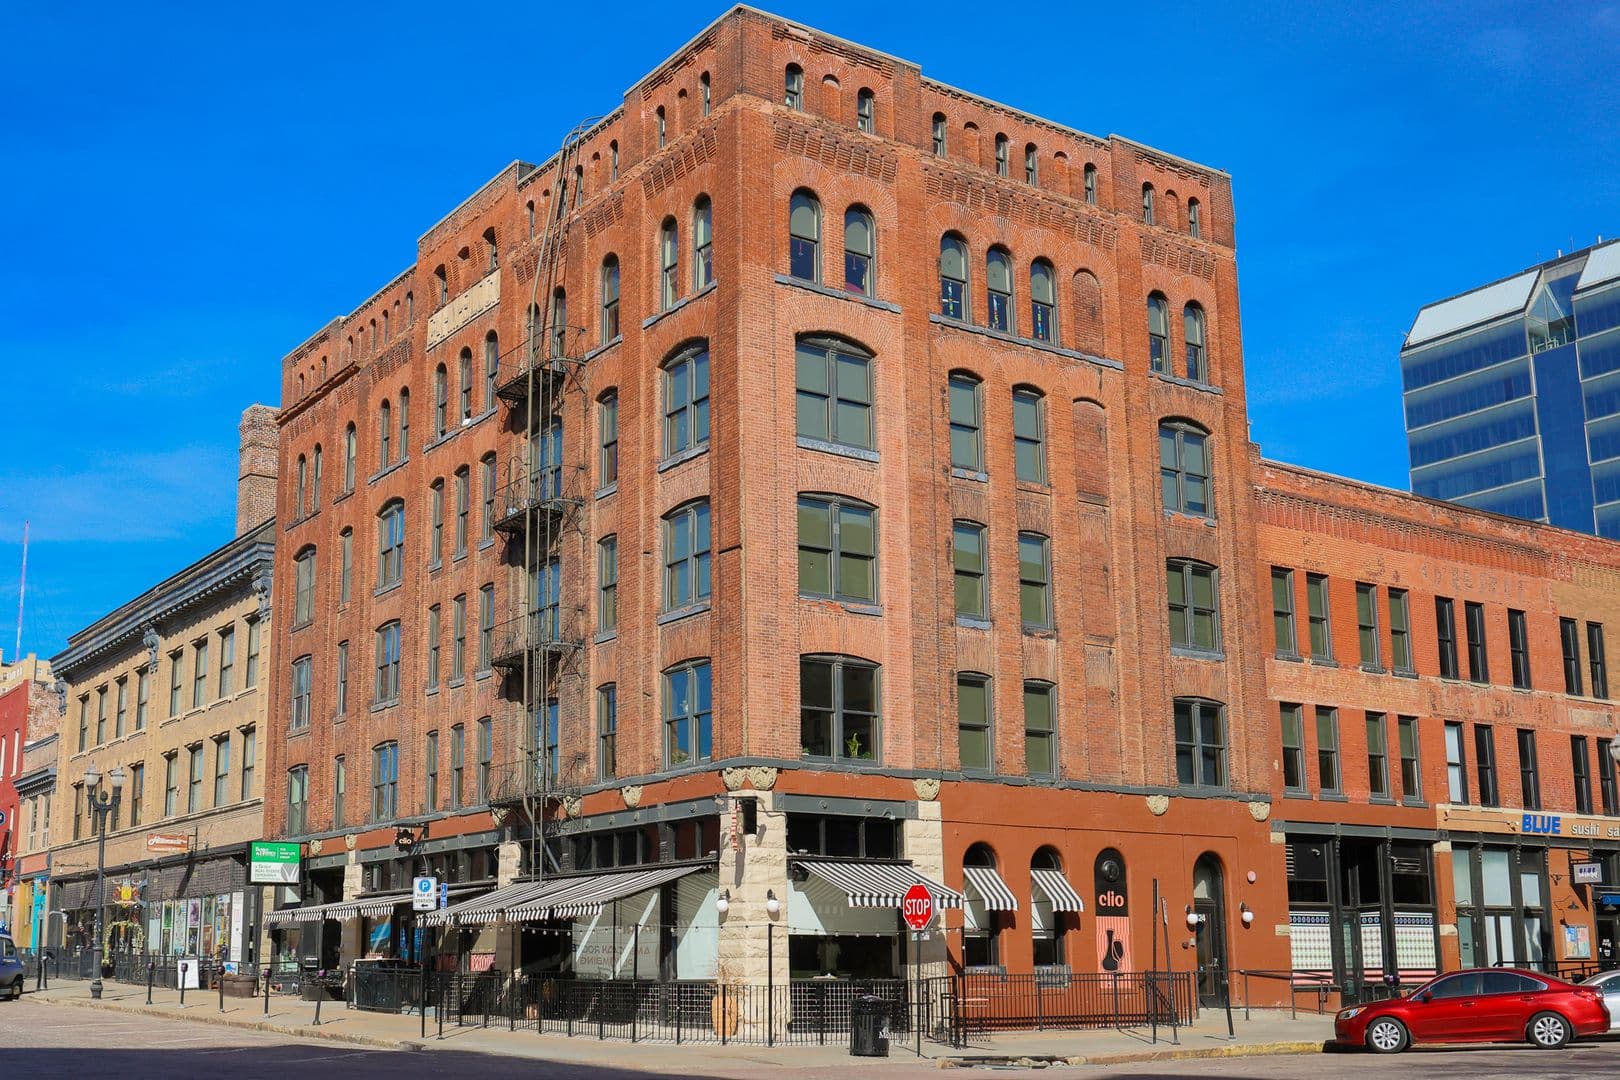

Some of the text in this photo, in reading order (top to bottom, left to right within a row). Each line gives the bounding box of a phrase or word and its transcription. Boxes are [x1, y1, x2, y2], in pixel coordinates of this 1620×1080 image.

[1522, 814, 1561, 834] BLUE
[1571, 823, 1600, 836] sushi
[905, 899, 931, 915] STOP
[1098, 890, 1125, 907] clio
